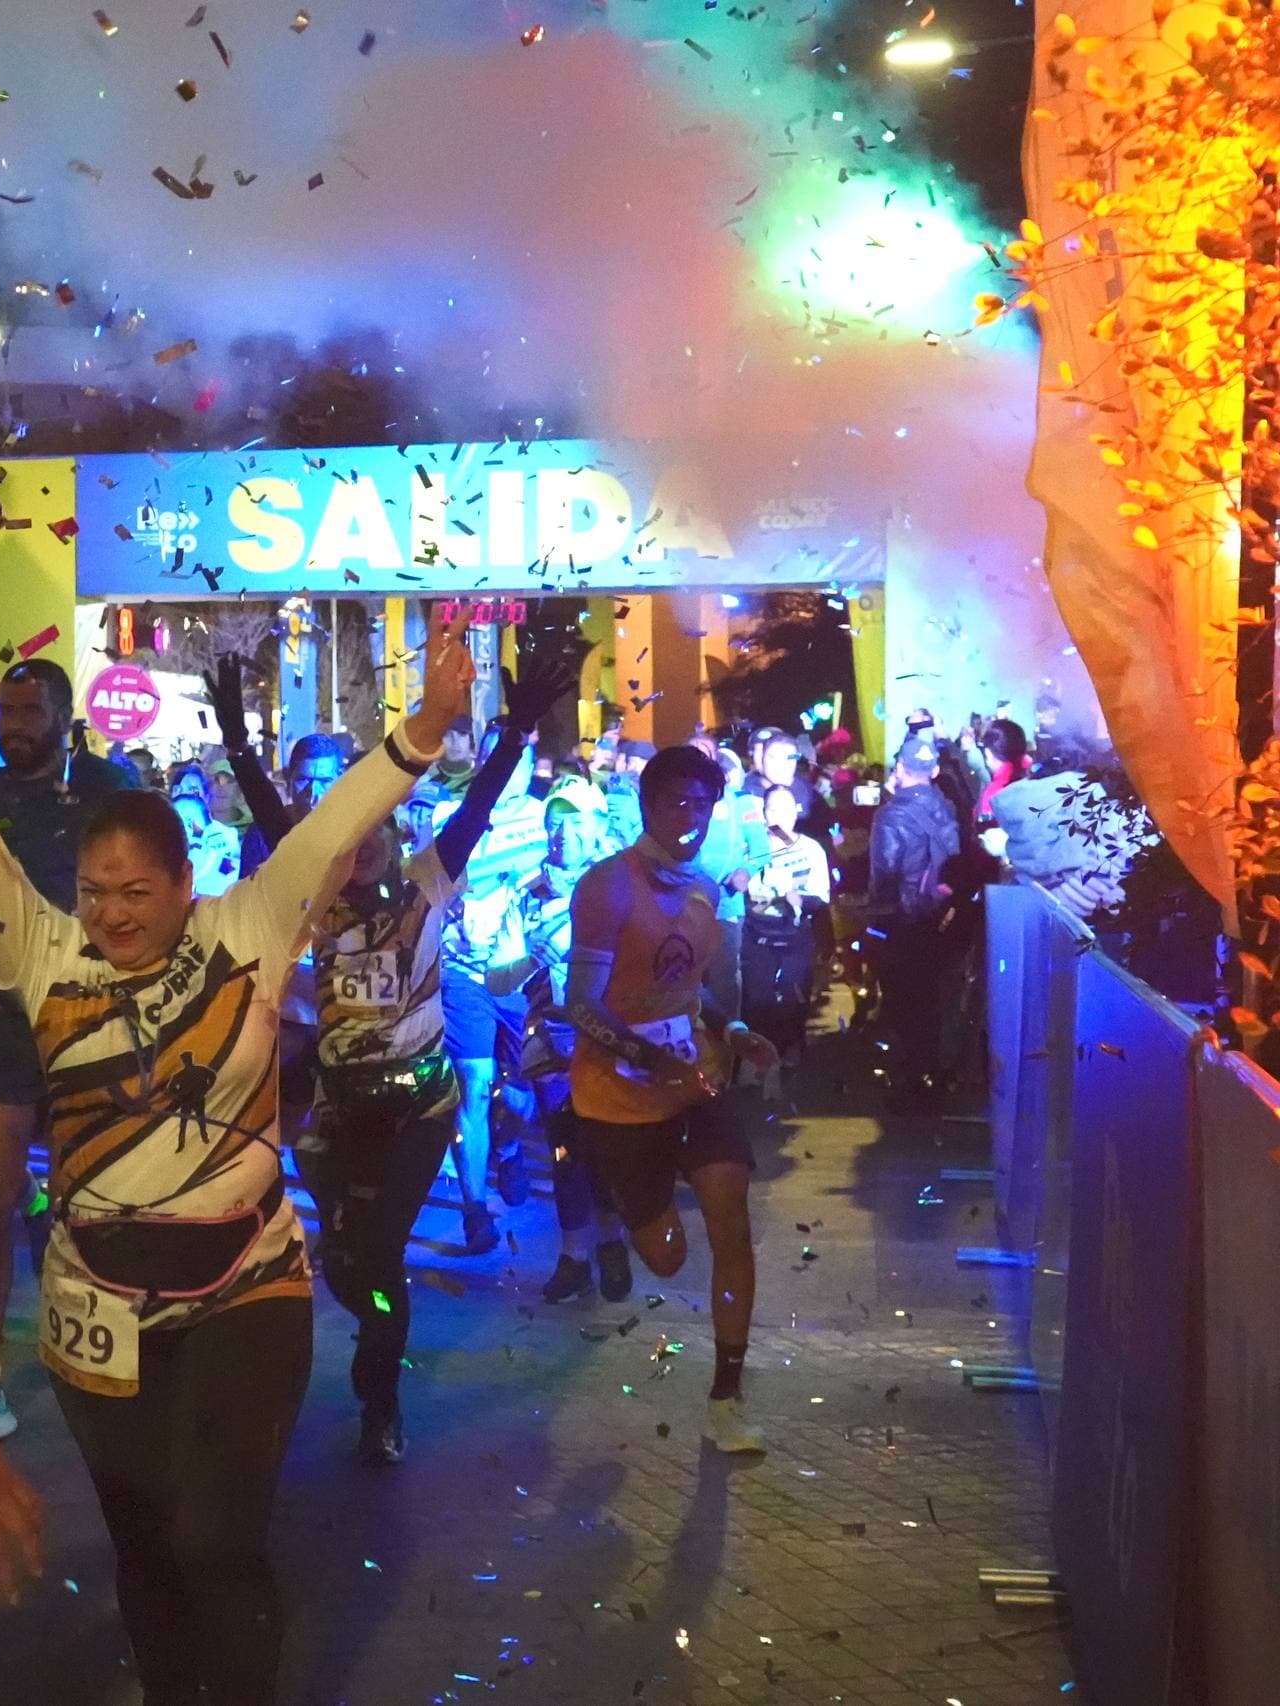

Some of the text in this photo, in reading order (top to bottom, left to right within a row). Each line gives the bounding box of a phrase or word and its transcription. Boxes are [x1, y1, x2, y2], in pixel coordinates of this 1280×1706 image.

[227, 469, 734, 571] SALIDA
[91, 689, 155, 713] ALTO
[341, 973, 395, 999] 612
[48, 1305, 114, 1365] 929
